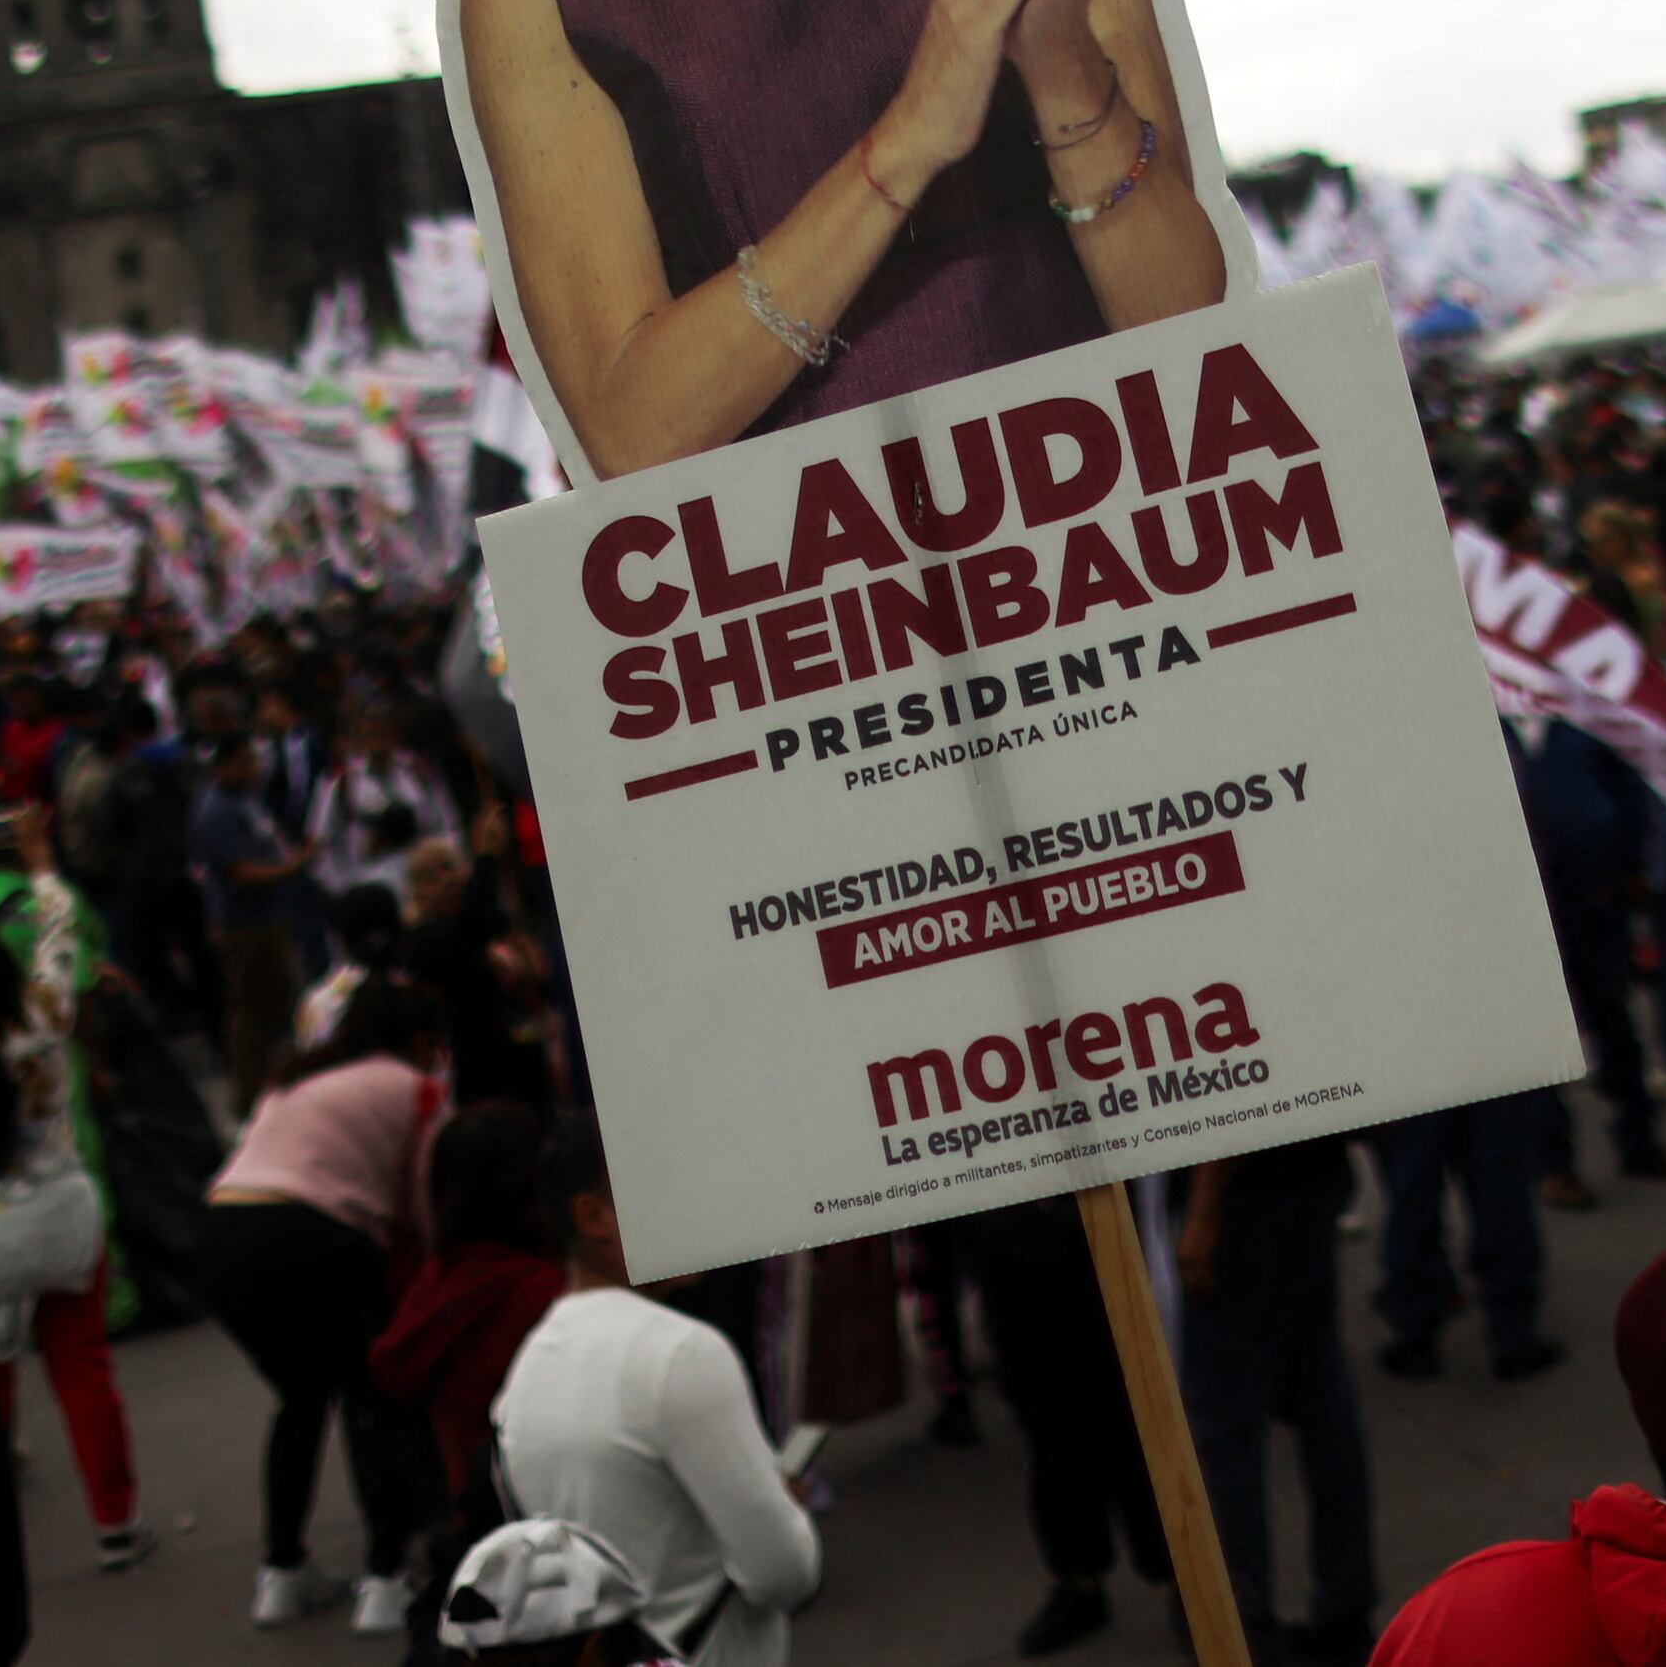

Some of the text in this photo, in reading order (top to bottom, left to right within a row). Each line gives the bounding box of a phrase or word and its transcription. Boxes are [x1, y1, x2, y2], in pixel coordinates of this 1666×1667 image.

[581, 342, 1320, 638] CLAUDIA
[602, 460, 1344, 740] SHEINBAUM
[765, 625, 1201, 773] PRESIDENTA
[844, 701, 1138, 791] PRECANDIDATA ÚNICA
[730, 762, 1307, 940] HONESTIDAD, RESULTADOS Y
[852, 852, 1207, 969] AMOR AL PUEBLO
[866, 982, 1261, 1129] morena
[881, 1058, 1270, 1166] La esperanza de México
[827, 1082, 1365, 1213] Mensaje dirigido a militantes, simpatizantes y Consejo Nacional de MORENA
